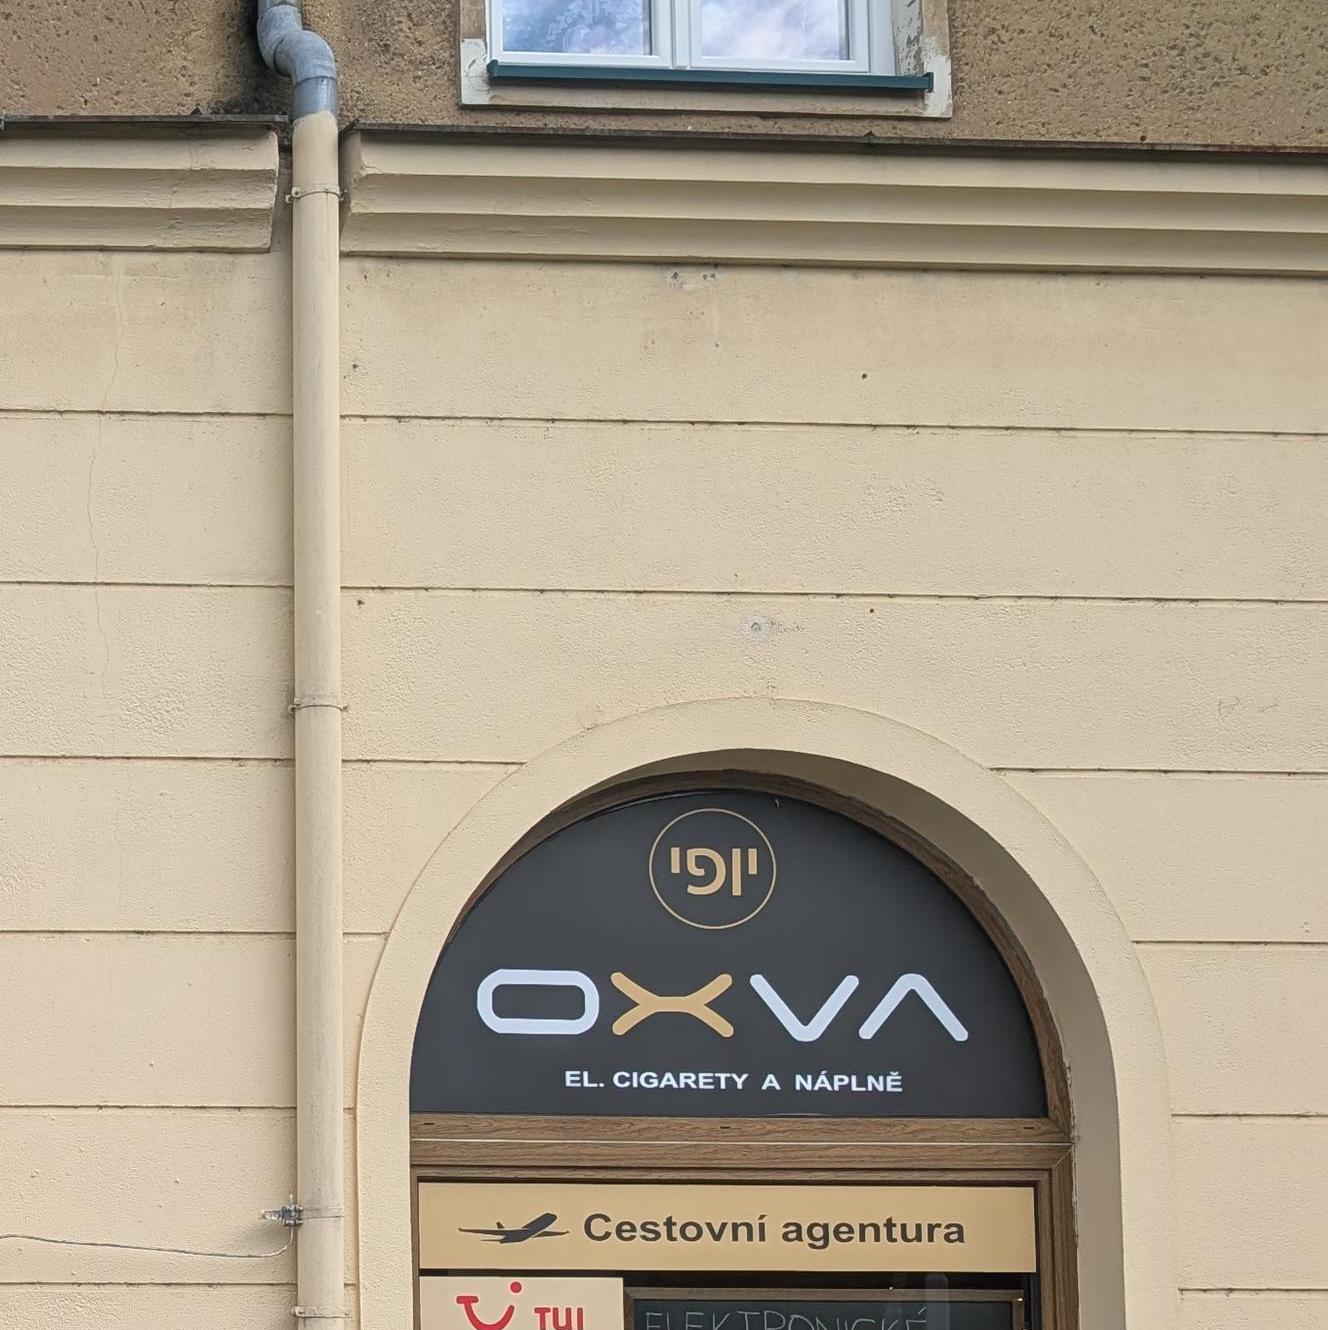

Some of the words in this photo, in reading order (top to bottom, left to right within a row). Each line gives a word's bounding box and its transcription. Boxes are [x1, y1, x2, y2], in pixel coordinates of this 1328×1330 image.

[476, 968, 970, 1043] OXVA
[564, 1070, 605, 1089] EL.
[612, 1071, 749, 1091] CIGARETY
[762, 1073, 782, 1092] A
[794, 1070, 904, 1094] NÁPLNĚ
[583, 1213, 768, 1243] Cestovní
[781, 1217, 966, 1250] agentura
